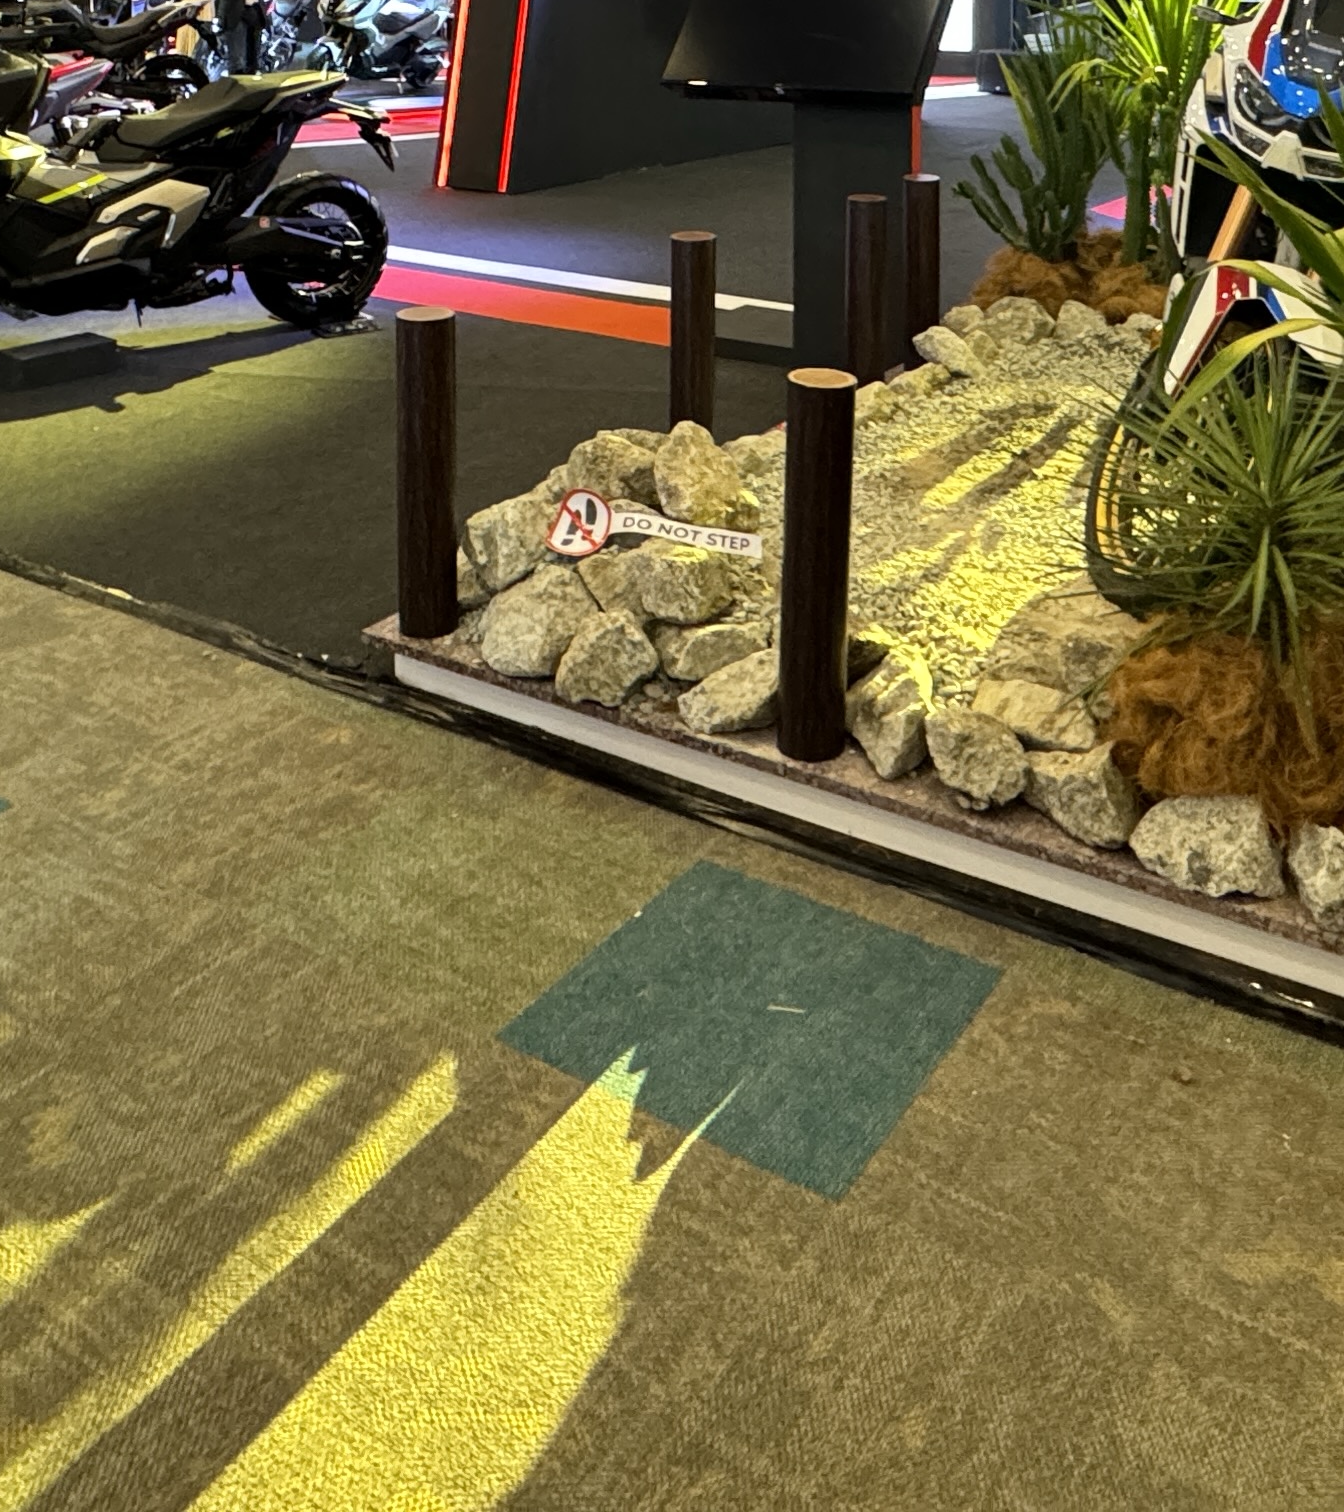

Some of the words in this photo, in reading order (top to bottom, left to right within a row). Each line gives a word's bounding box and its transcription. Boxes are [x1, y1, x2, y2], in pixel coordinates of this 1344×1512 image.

[622, 516, 652, 530] DO
[658, 523, 702, 542] NOT
[707, 533, 750, 551] STEP
